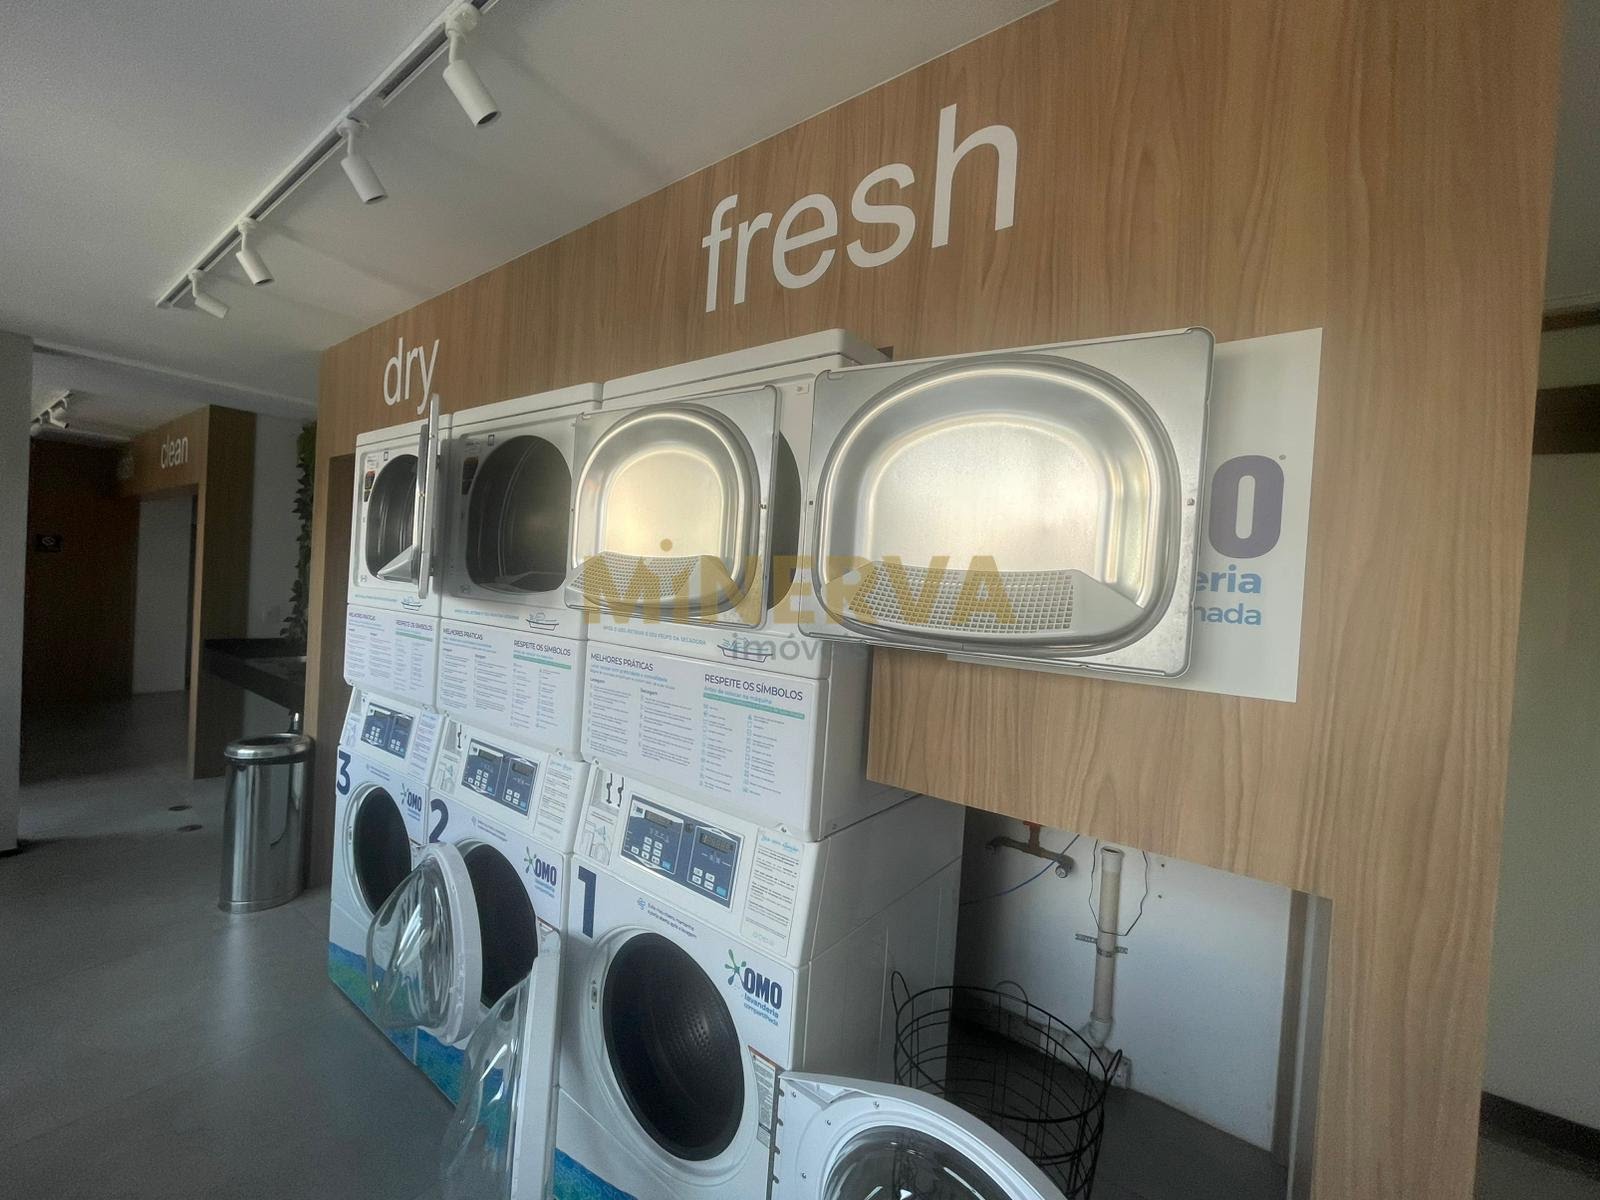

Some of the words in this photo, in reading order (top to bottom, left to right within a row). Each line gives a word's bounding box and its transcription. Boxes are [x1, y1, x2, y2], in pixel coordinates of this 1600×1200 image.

[702, 104, 1018, 313] fresh
[384, 336, 440, 415] dry
[160, 433, 189, 470] clean
[590, 652, 622, 666] MELHORES
[623, 657, 654, 672] PRÁTICAS
[704, 673, 742, 689] RESPEITE
[743, 680, 755, 692] OS
[756, 682, 804, 702] SÍMBOLOS
[337, 750, 351, 795] 3
[407, 791, 422, 812] OMO
[429, 798, 449, 843] 2
[534, 858, 557, 886] OMO
[578, 865, 597, 939] 1
[743, 967, 782, 1010] OMO
[744, 992, 779, 1018] lavanderia
